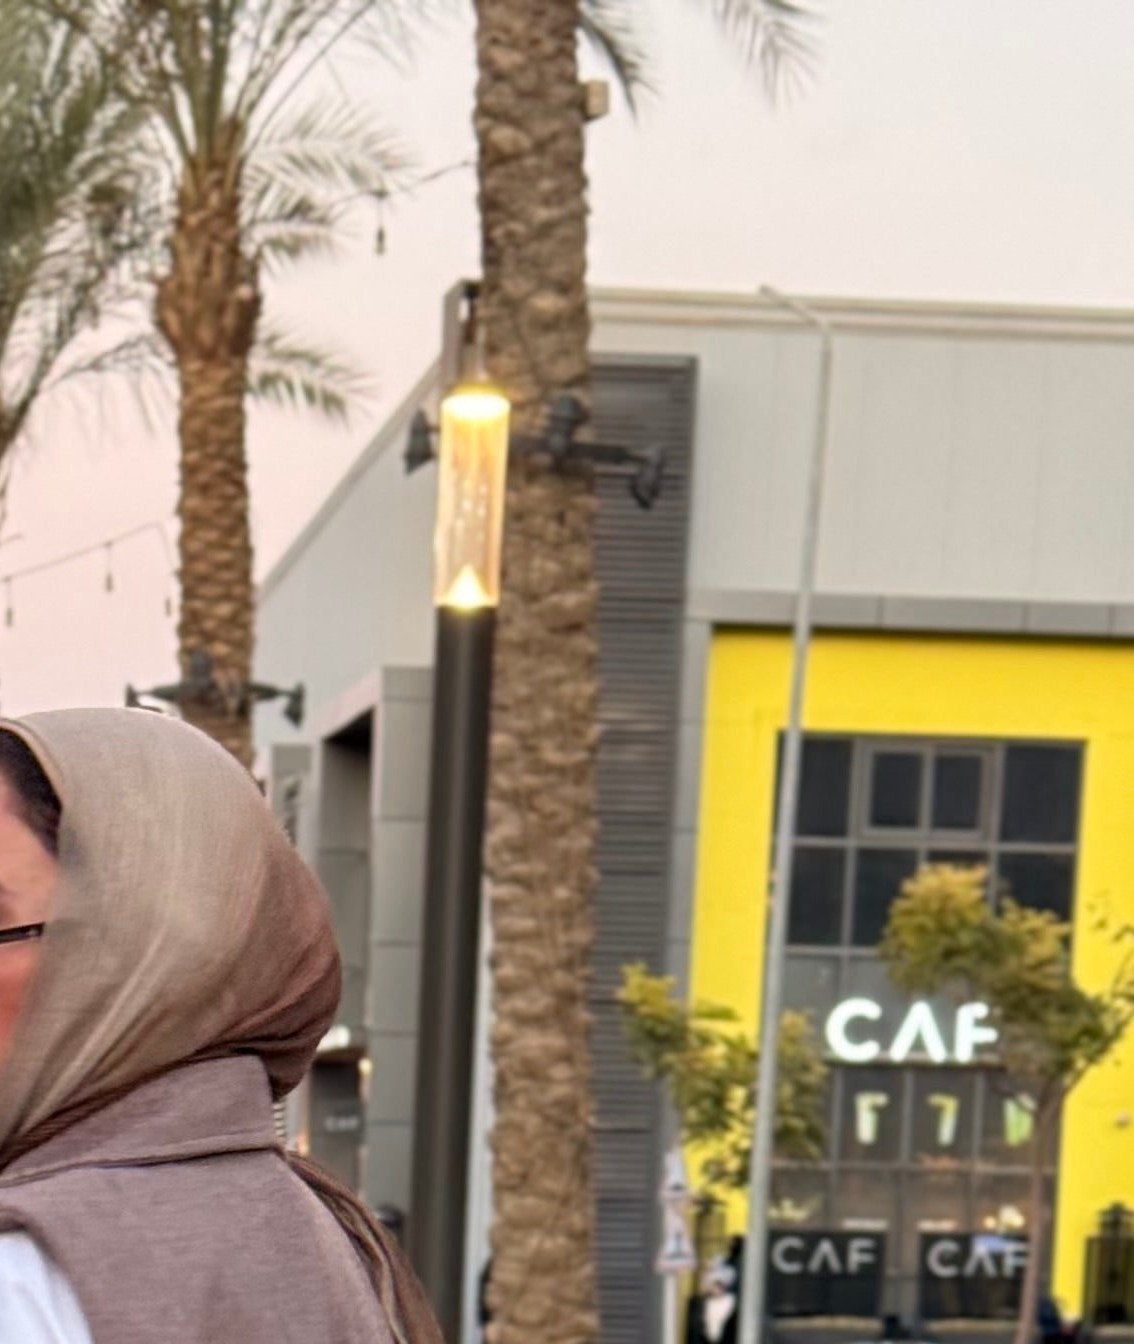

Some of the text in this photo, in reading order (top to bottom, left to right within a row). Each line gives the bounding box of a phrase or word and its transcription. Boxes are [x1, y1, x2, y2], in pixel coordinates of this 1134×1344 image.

[825, 997, 999, 1063] CAF
[771, 1236, 877, 1274] CAF
[926, 1239, 1029, 1278] CAF
